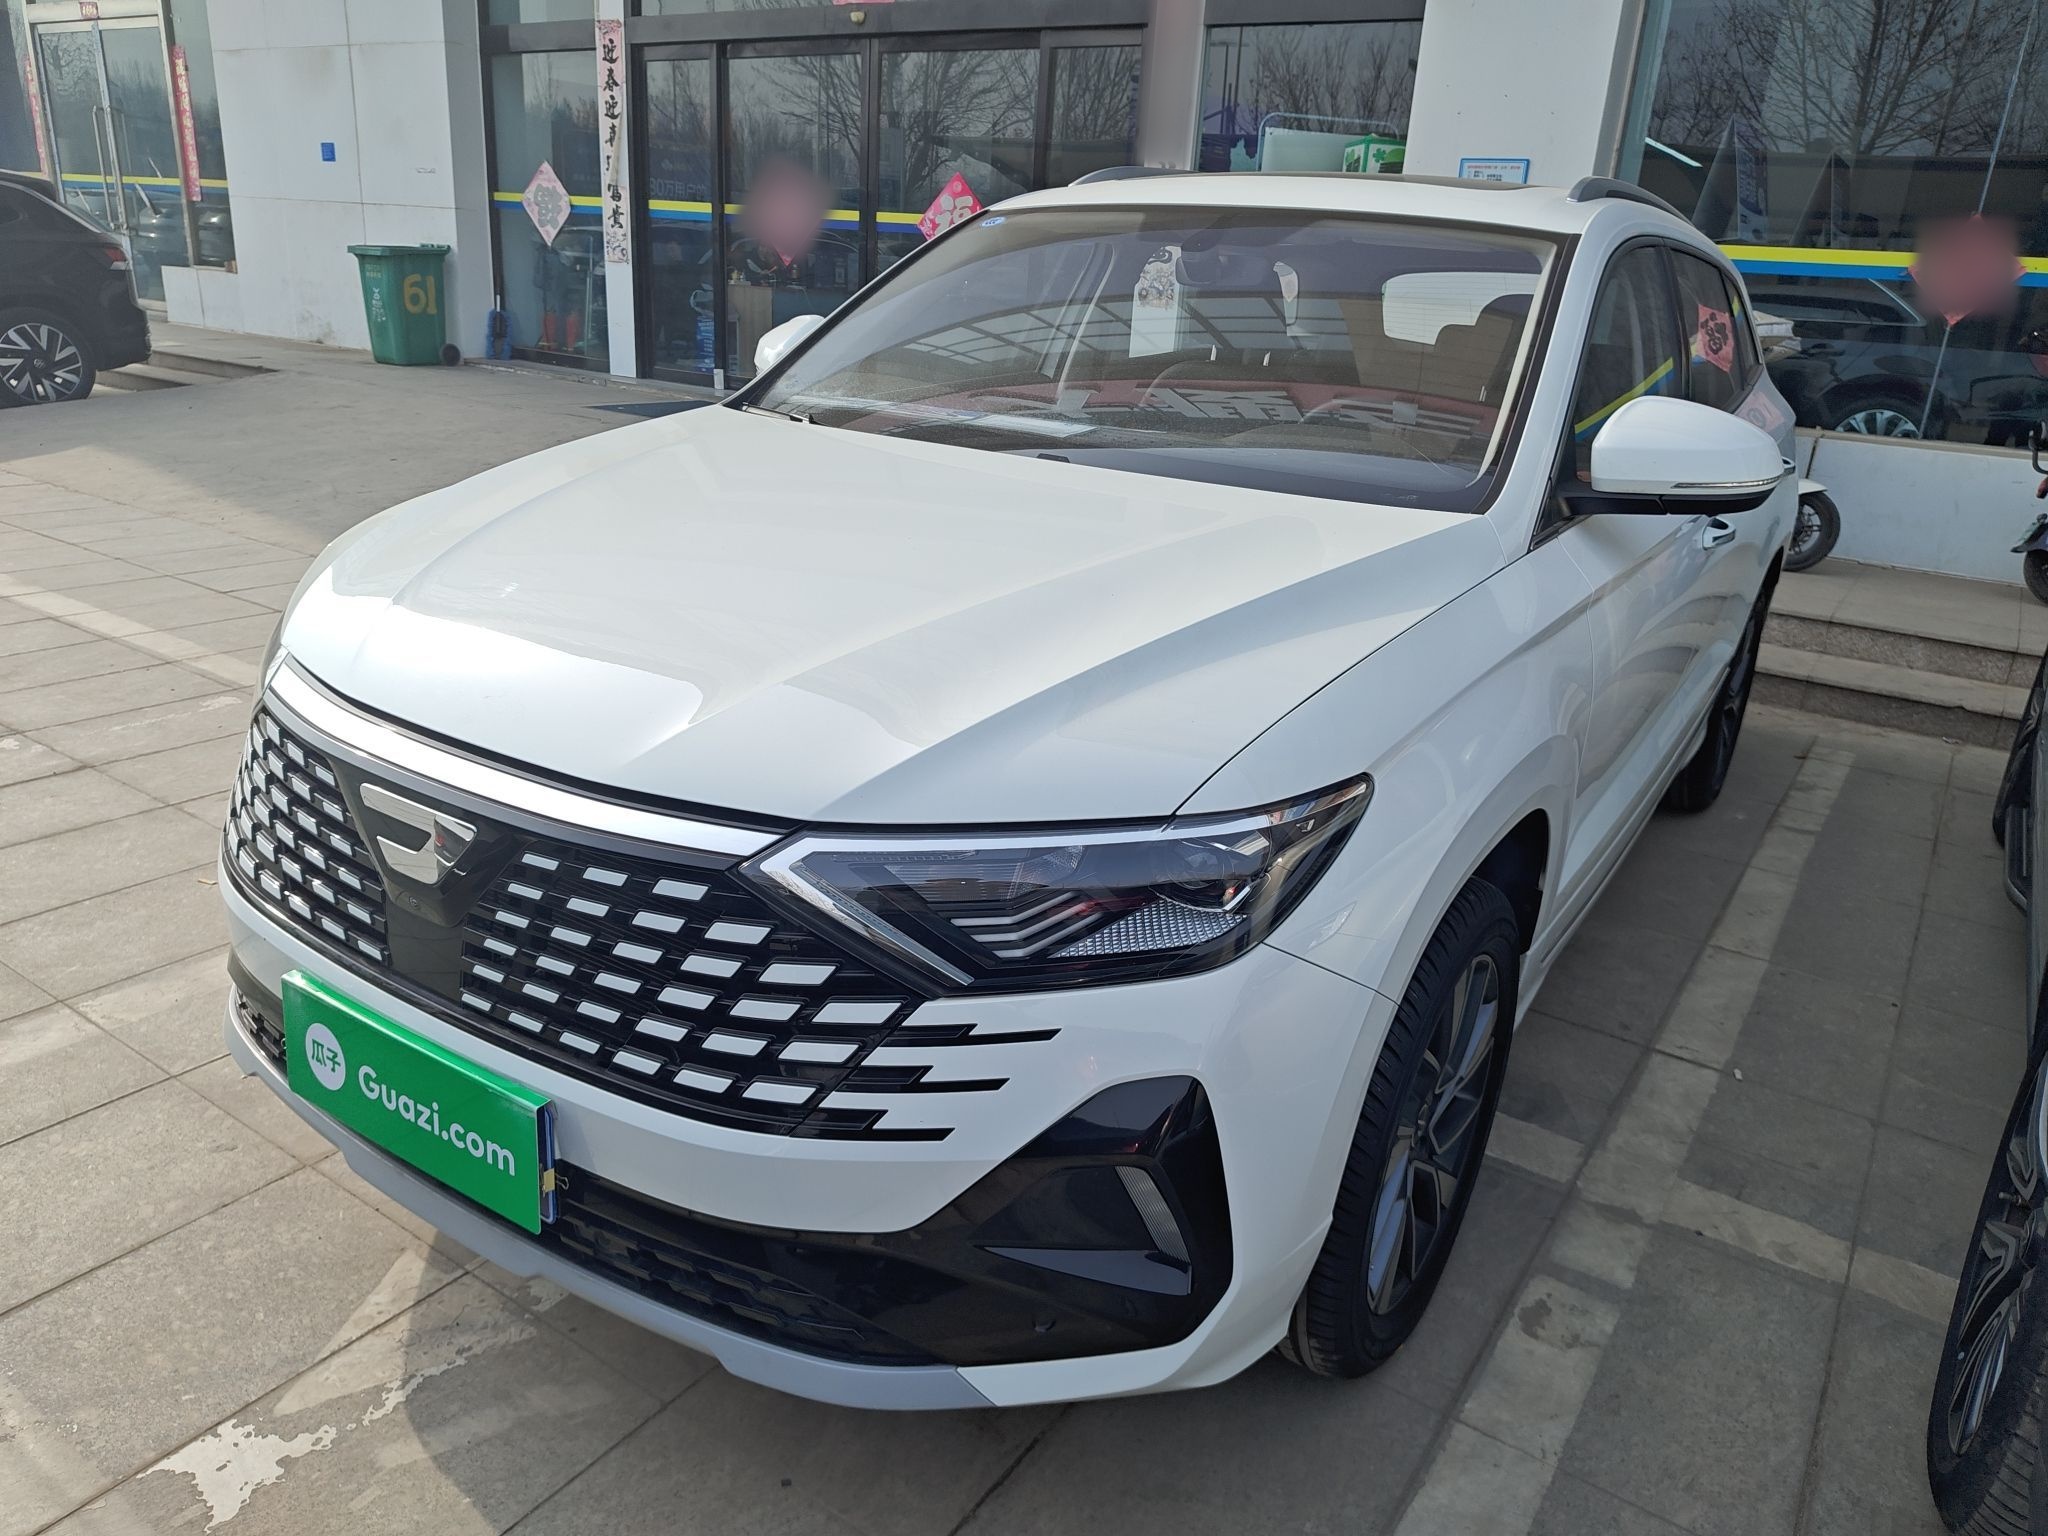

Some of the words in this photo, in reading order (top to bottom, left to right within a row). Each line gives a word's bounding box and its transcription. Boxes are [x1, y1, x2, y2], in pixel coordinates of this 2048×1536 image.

[404, 273, 437, 314] 61
[311, 1038, 341, 1073] 瓜子
[358, 1065, 516, 1177] Guazi.com
